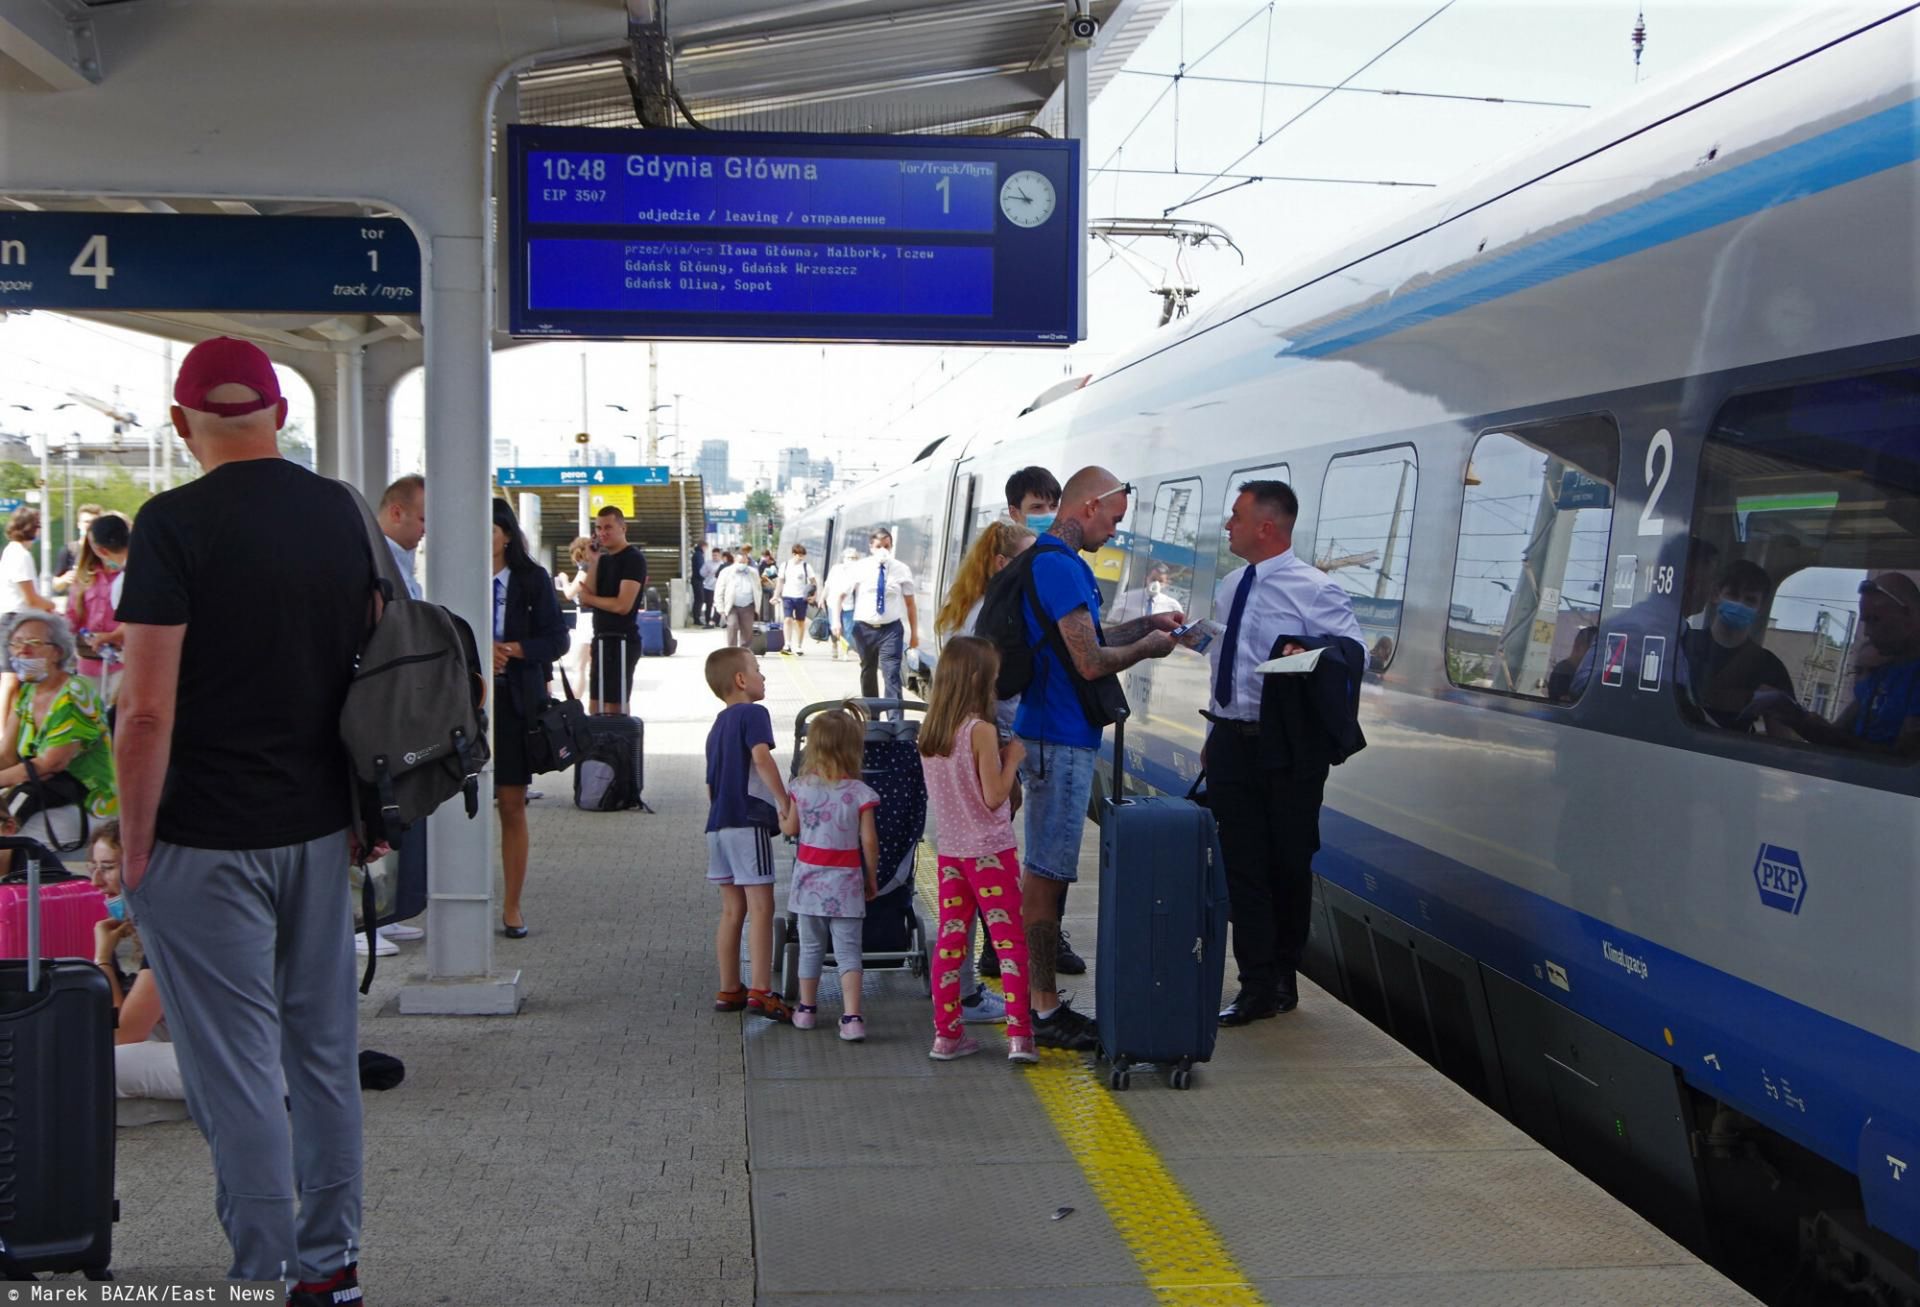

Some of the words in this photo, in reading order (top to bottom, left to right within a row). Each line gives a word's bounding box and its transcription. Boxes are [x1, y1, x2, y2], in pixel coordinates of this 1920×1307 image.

[543, 158, 607, 181] 10:48
[627, 155, 713, 182] Gdynia
[725, 157, 818, 181] Główna
[543, 189, 567, 201] EIP
[575, 190, 607, 202] 3507
[935, 176, 950, 214] 1
[638, 209, 700, 223] odjedzie
[708, 210, 716, 221] /
[725, 210, 779, 224] leaving
[785, 211, 793, 223] /
[801, 213, 886, 226] отправление
[361, 228, 385, 239] tor
[719, 244, 758, 256] Iława
[765, 245, 819, 258] Główna,
[827, 246, 887, 259] Malbork,
[896, 247, 934, 259] Tczew
[69, 234, 115, 290] 4
[367, 250, 379, 272] 1
[625, 259, 672, 272] Gdańsk
[680, 260, 733, 275] Główny,
[742, 261, 788, 274] Gdańsk
[795, 262, 857, 275] Wrzeszcz
[333, 282, 368, 296] track
[625, 277, 672, 289] Gdańsk
[680, 278, 726, 291] Oliwa,
[734, 279, 772, 292] Sopot
[593, 469, 604, 483] 4
[1637, 428, 1674, 536] 2
[1644, 565, 1674, 595] 11-58
[1761, 861, 1800, 895] PKP
[1602, 939, 1648, 980] Klimatyzacja
[332, 1286, 362, 1304] PUM
